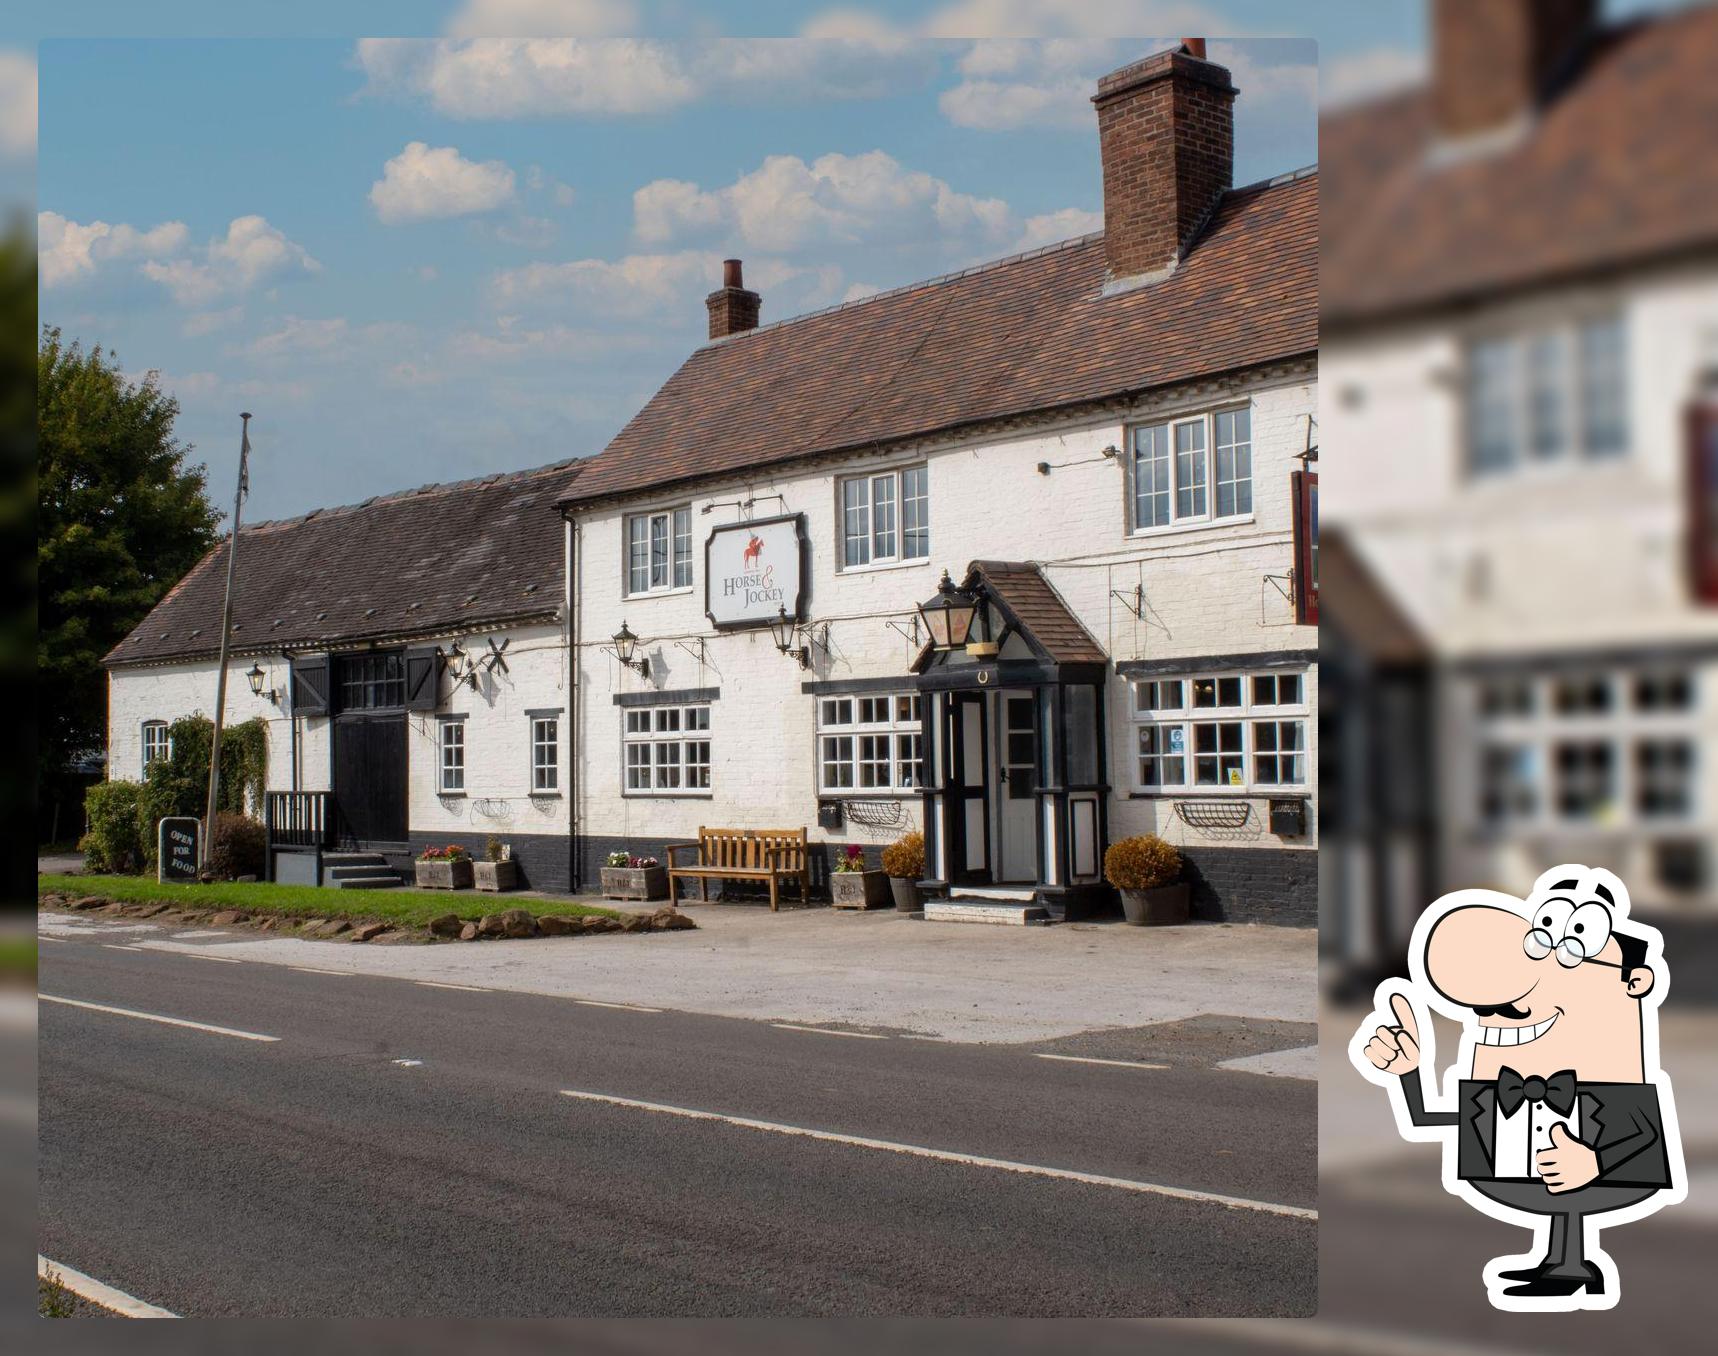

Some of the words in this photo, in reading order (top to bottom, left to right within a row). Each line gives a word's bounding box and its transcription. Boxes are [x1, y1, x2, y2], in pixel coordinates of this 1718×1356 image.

[723, 575, 762, 597] HORSE
[762, 565, 773, 589] &
[744, 588, 784, 608] JOCKEY
[170, 830, 194, 845] OPEN
[173, 846, 190, 855] FOR
[171, 858, 195, 874] FOOD
